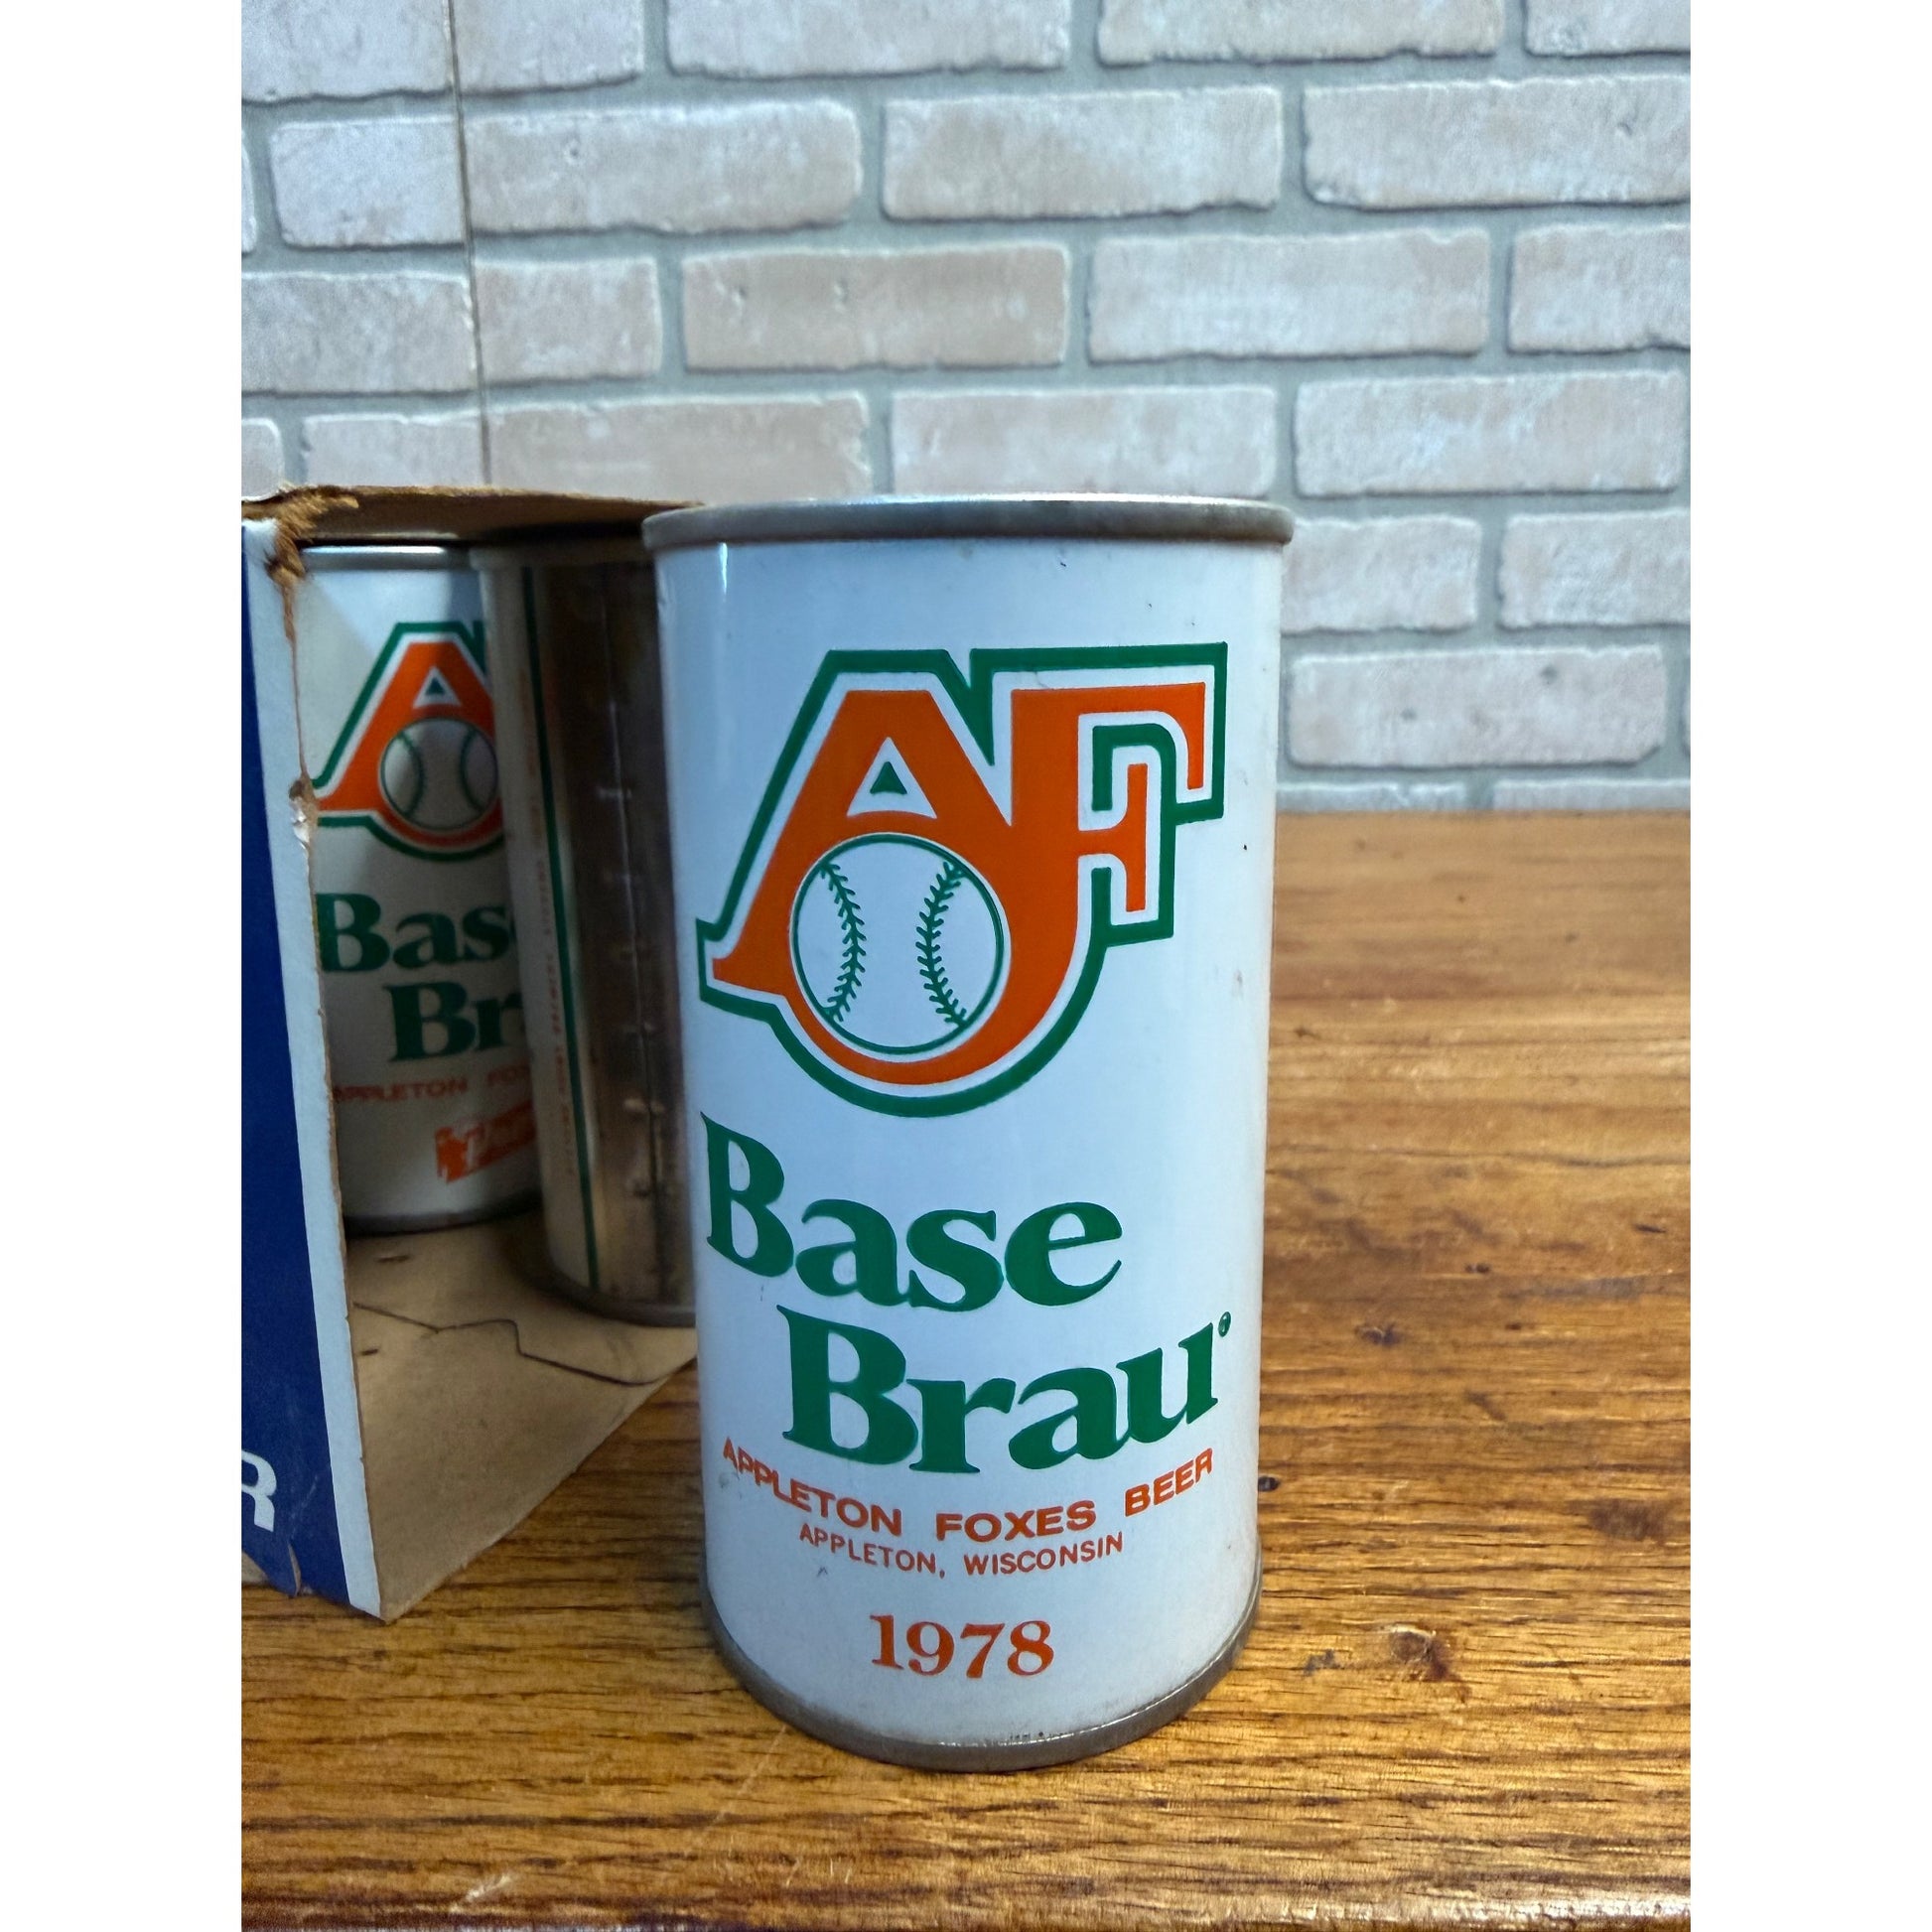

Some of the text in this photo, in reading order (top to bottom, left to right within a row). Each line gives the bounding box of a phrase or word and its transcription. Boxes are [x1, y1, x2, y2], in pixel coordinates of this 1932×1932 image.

[315, 892, 516, 972] Bas
[381, 980, 524, 1063] Br
[701, 1112, 1123, 1312] Base
[723, 1438, 1214, 1543] APPLETON FOXES BEER
[799, 1522, 1124, 1579] APPLETON, WISCONSIN
[870, 1613, 1055, 1679] 1978
